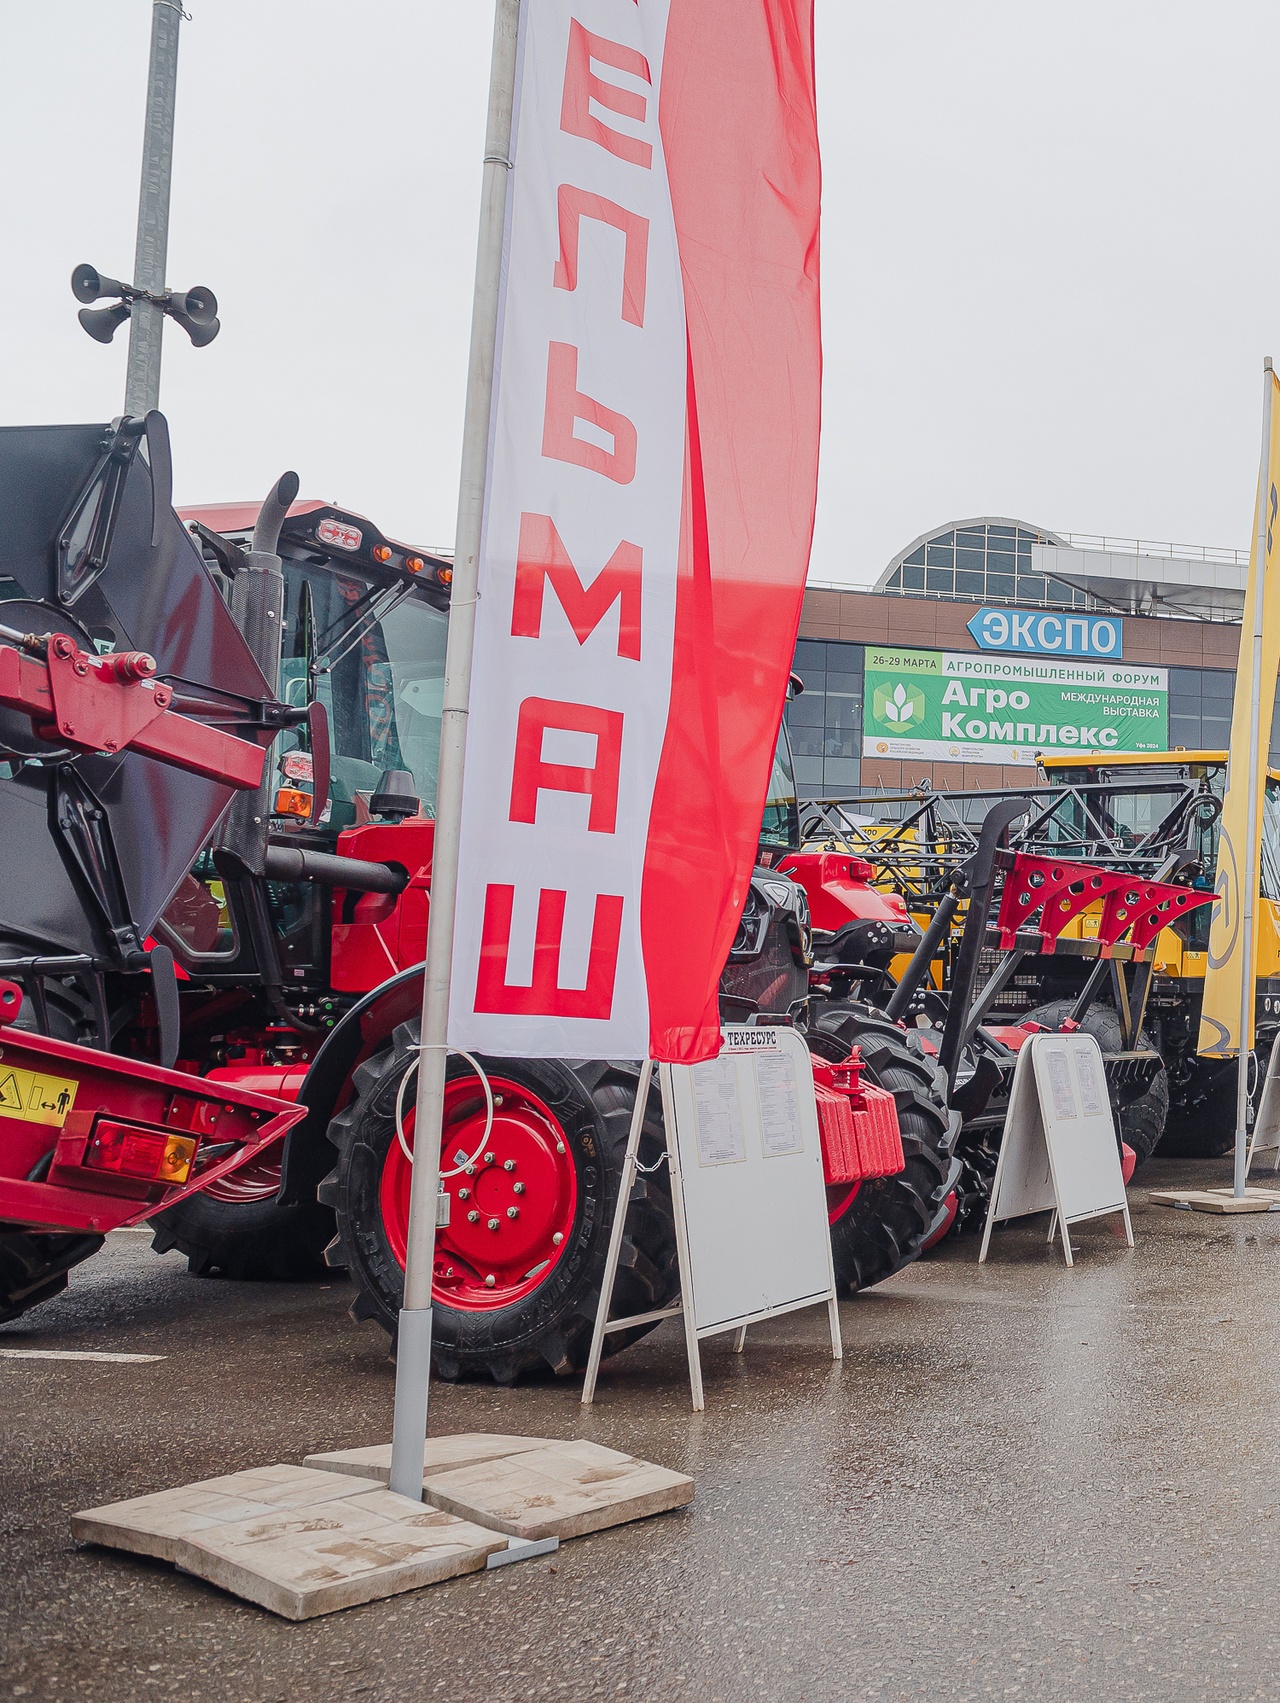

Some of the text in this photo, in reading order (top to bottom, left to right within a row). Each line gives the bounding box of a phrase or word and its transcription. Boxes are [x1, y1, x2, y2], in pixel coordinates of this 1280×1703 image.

[473, 0, 653, 1020] ЕЛЬМАШ
[981, 611, 1117, 655] ЭКСПО
[872, 655, 937, 669] 26-29 МАРТА
[946, 660, 1160, 686] АГРОПРОМЫШЛЕННЫЙ ФОРУМ
[941, 680, 1031, 714] Агро
[1060, 691, 1160, 707] МЕЖДУНАРОДНАЯ
[1102, 705, 1160, 718] ВЫСТАВКА
[941, 711, 1119, 747] Комплекс
[727, 1031, 777, 1046] ТЕХРЕСУРС
